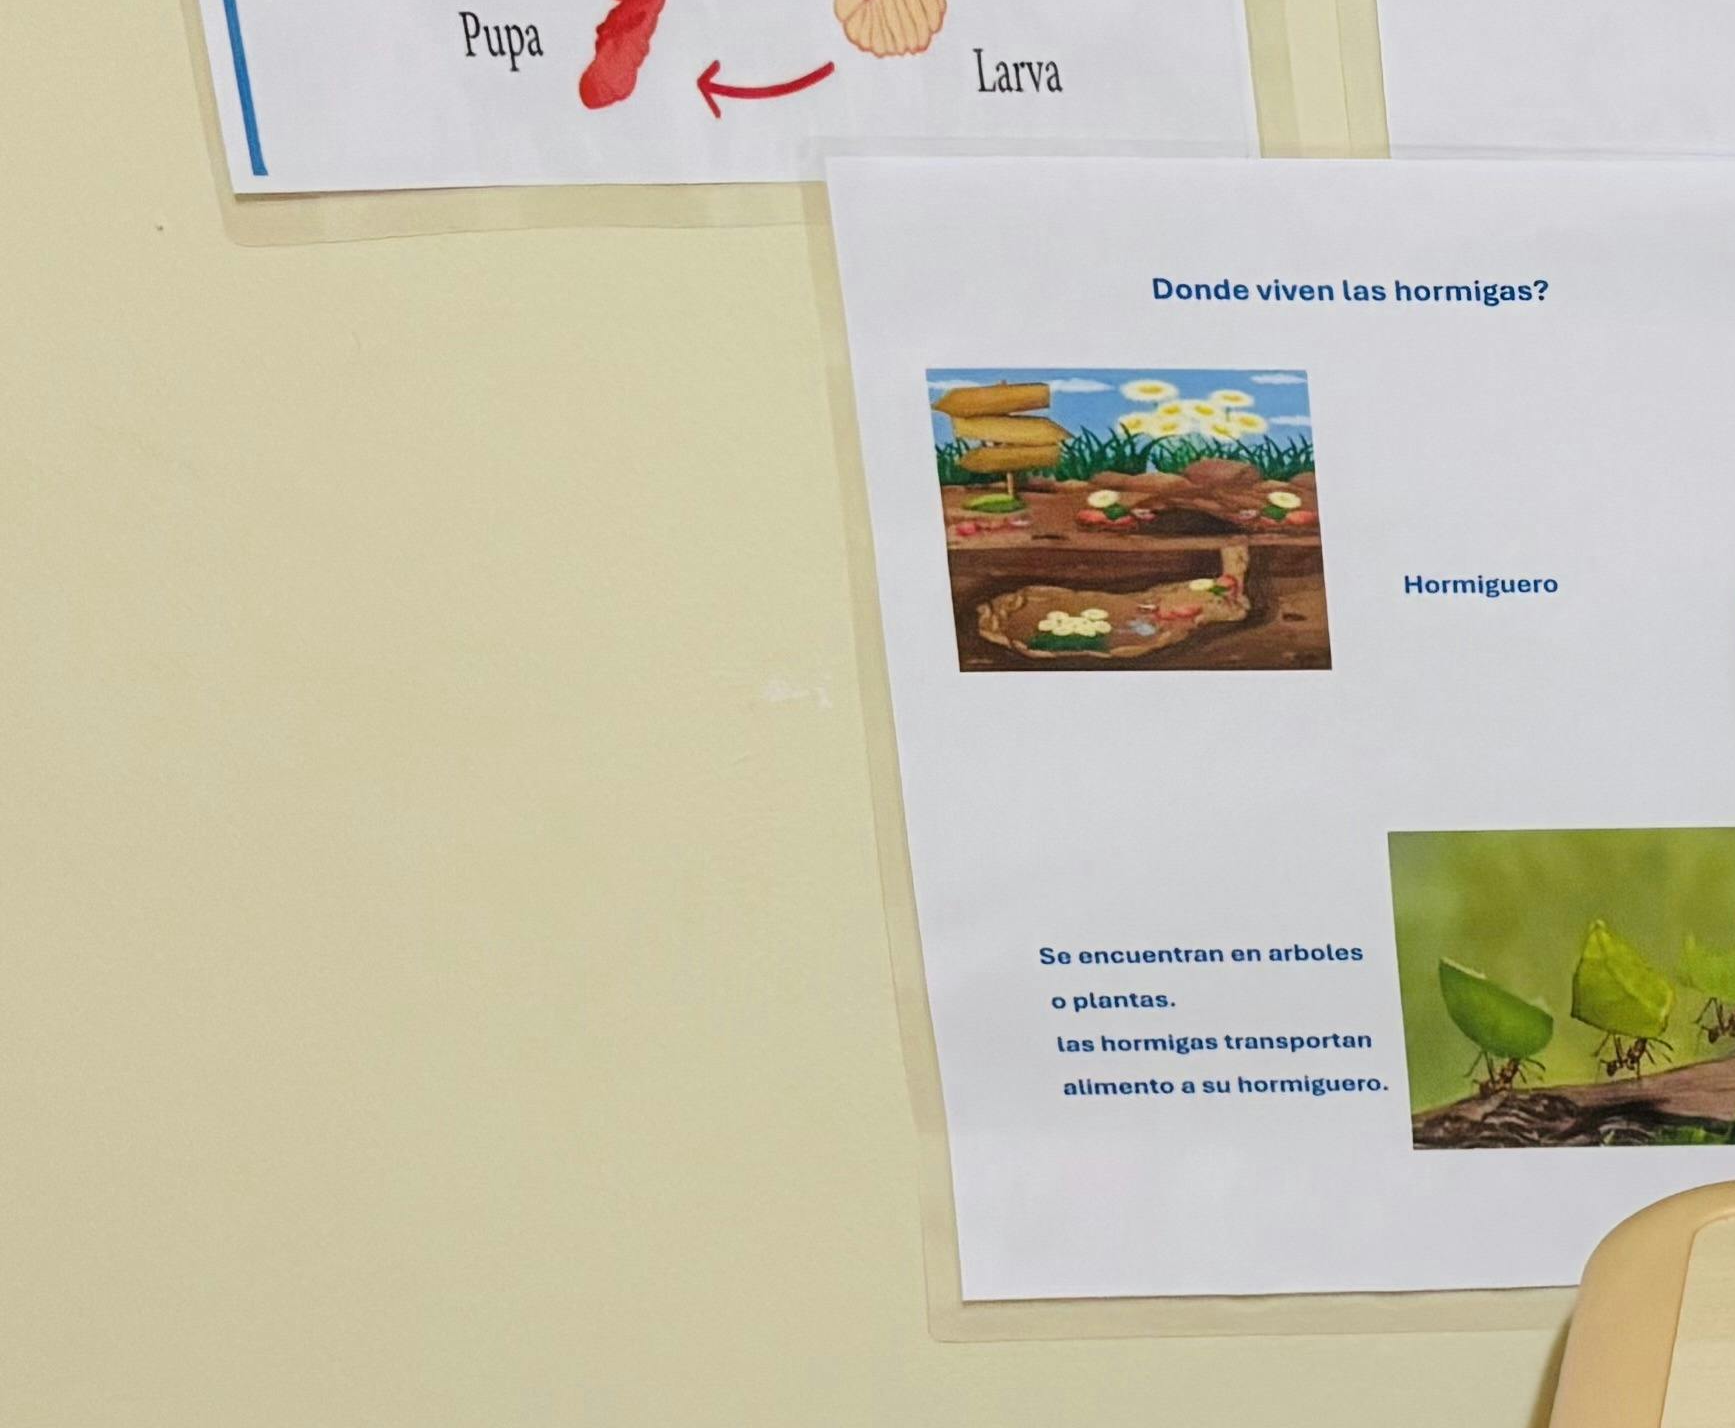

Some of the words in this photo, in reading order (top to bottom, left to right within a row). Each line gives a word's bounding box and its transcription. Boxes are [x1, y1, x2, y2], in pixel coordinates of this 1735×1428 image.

[458, 11, 545, 69] Pupa
[972, 47, 1064, 94] Larva
[1152, 277, 1250, 301] Donde
[1255, 278, 1335, 302] viven
[1342, 279, 1387, 302] las
[1394, 279, 1549, 307] hormigas?
[1404, 574, 1559, 599] Hormiguero
[1039, 947, 1072, 966] Se
[1078, 947, 1225, 965] encuentran
[1230, 948, 1262, 963] en
[1268, 943, 1364, 962] arboles
[1051, 996, 1067, 1010] o
[1072, 991, 1176, 1013] plantas.
[1056, 1036, 1095, 1053] las
[1100, 1033, 1219, 1056] hormigas
[1223, 1033, 1372, 1053] transportan
[1063, 1078, 1175, 1096] alimento
[1180, 1080, 1196, 1095] a
[1201, 1080, 1231, 1094] su
[1237, 1074, 1389, 1097] hormiguero.
